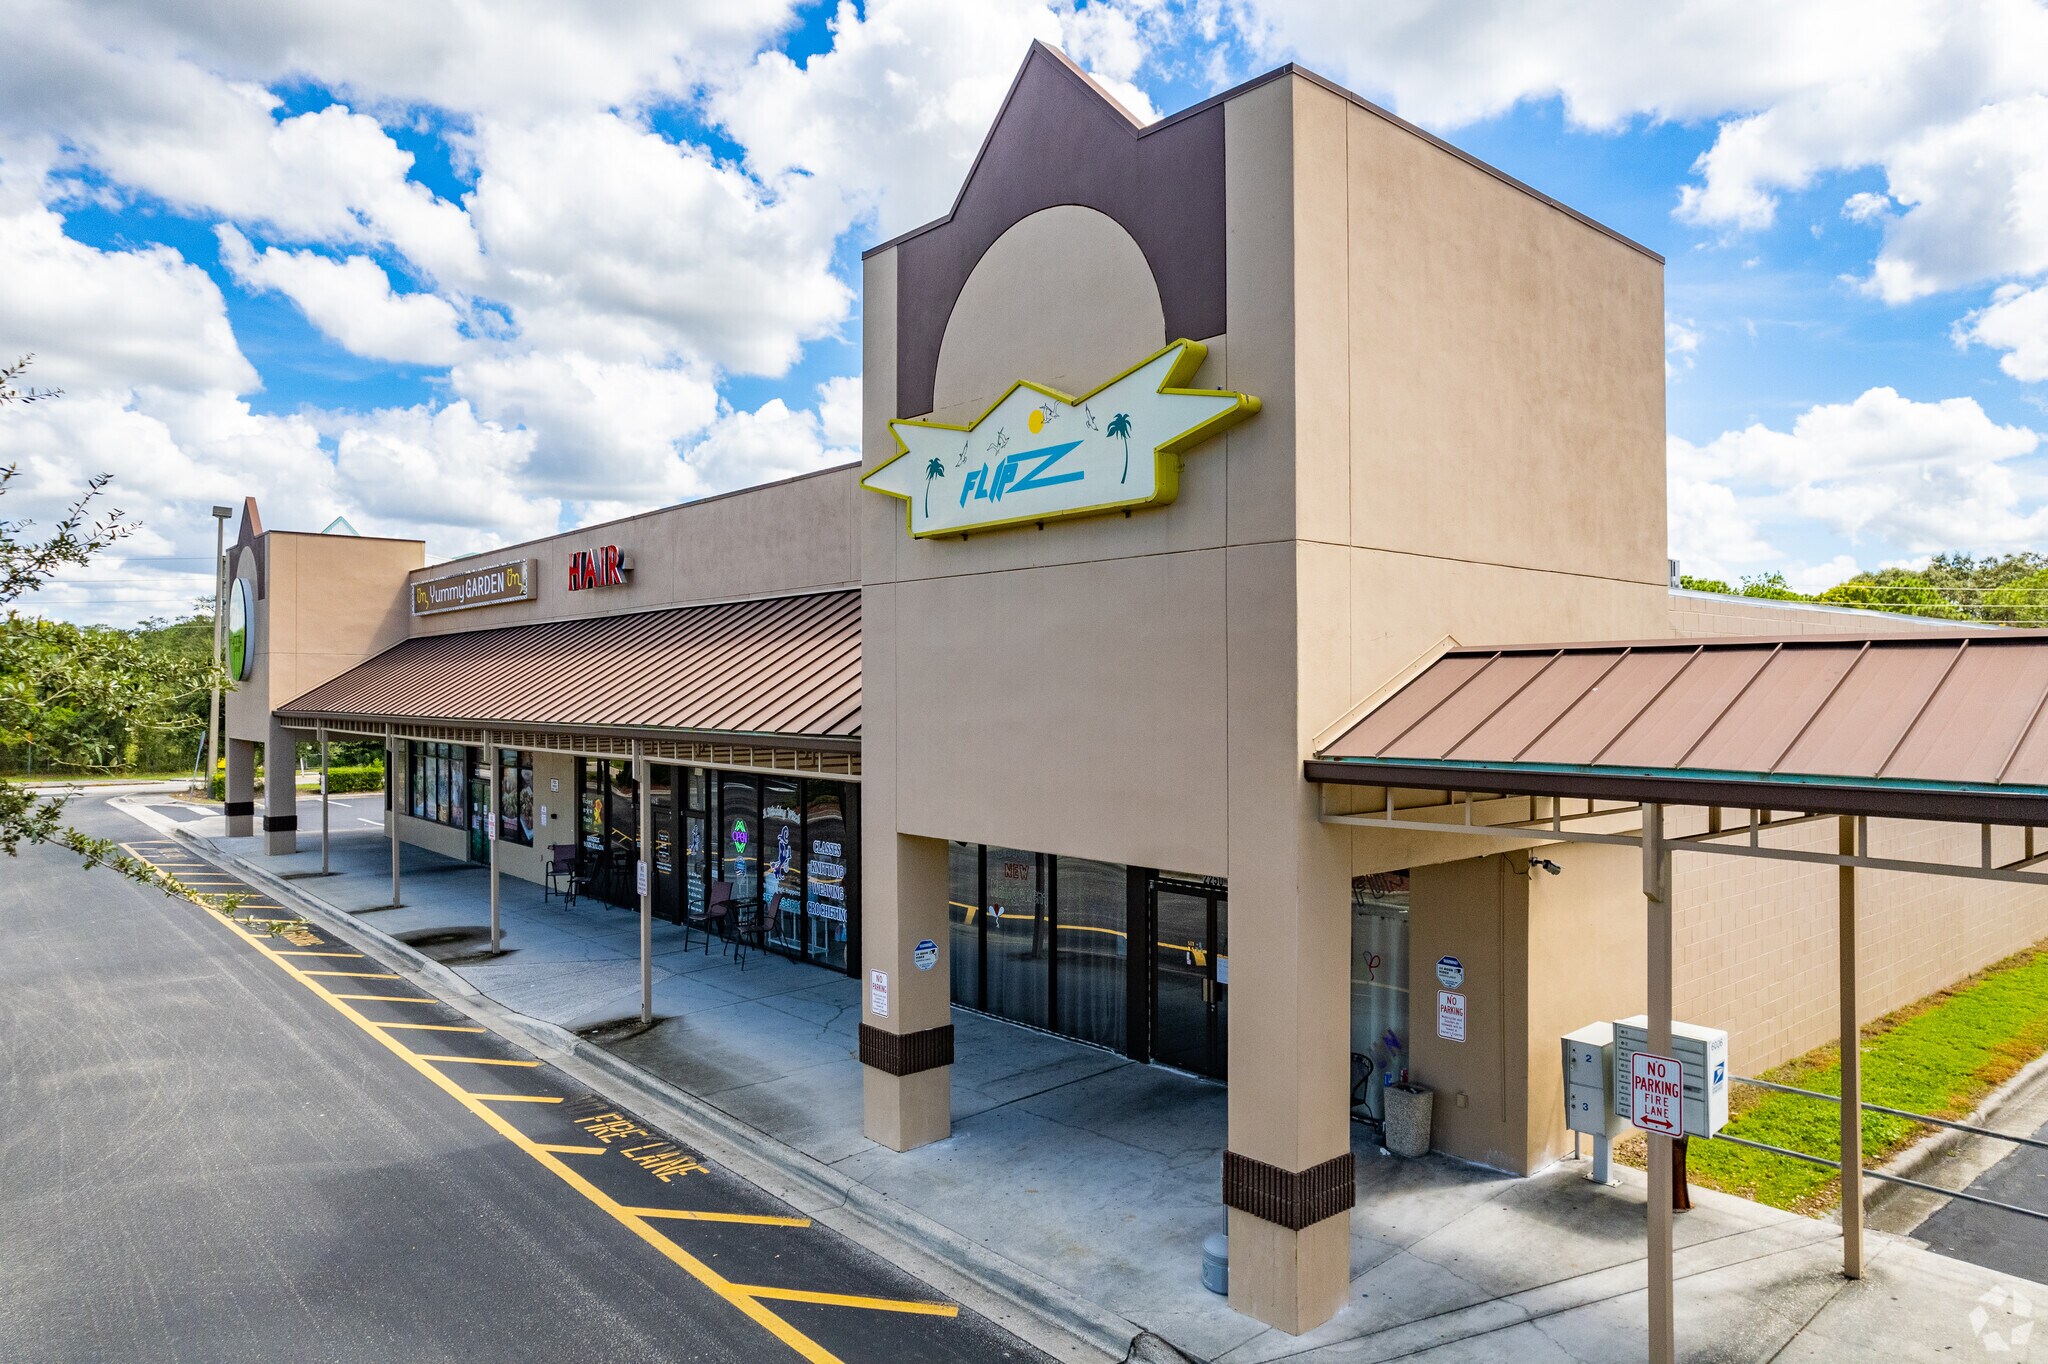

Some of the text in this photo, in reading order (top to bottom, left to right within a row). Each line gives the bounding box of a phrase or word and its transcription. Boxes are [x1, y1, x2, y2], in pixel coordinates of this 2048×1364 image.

[960, 440, 1084, 508] FLIPZ
[568, 545, 624, 591] HAIR
[430, 571, 504, 606] Yummy GARDEN
[732, 831, 748, 843] OPEN
[813, 840, 842, 857] CLASSES
[811, 860, 844, 879] KNITTING
[1004, 863, 1029, 881] NEW
[812, 882, 844, 901] WEAVING
[1447, 996, 1457, 1005] NO
[1441, 1005, 1463, 1016] PARKING
[1586, 1054, 1592, 1062] 2
[1647, 1062, 1666, 1078] NO
[1635, 1076, 1679, 1098] PARKING
[1582, 1103, 1589, 1111] 3
[1644, 1093, 1669, 1107] FIRE
[1644, 1105, 1669, 1119] LANE
[574, 1112, 710, 1183] FIRE LANE
